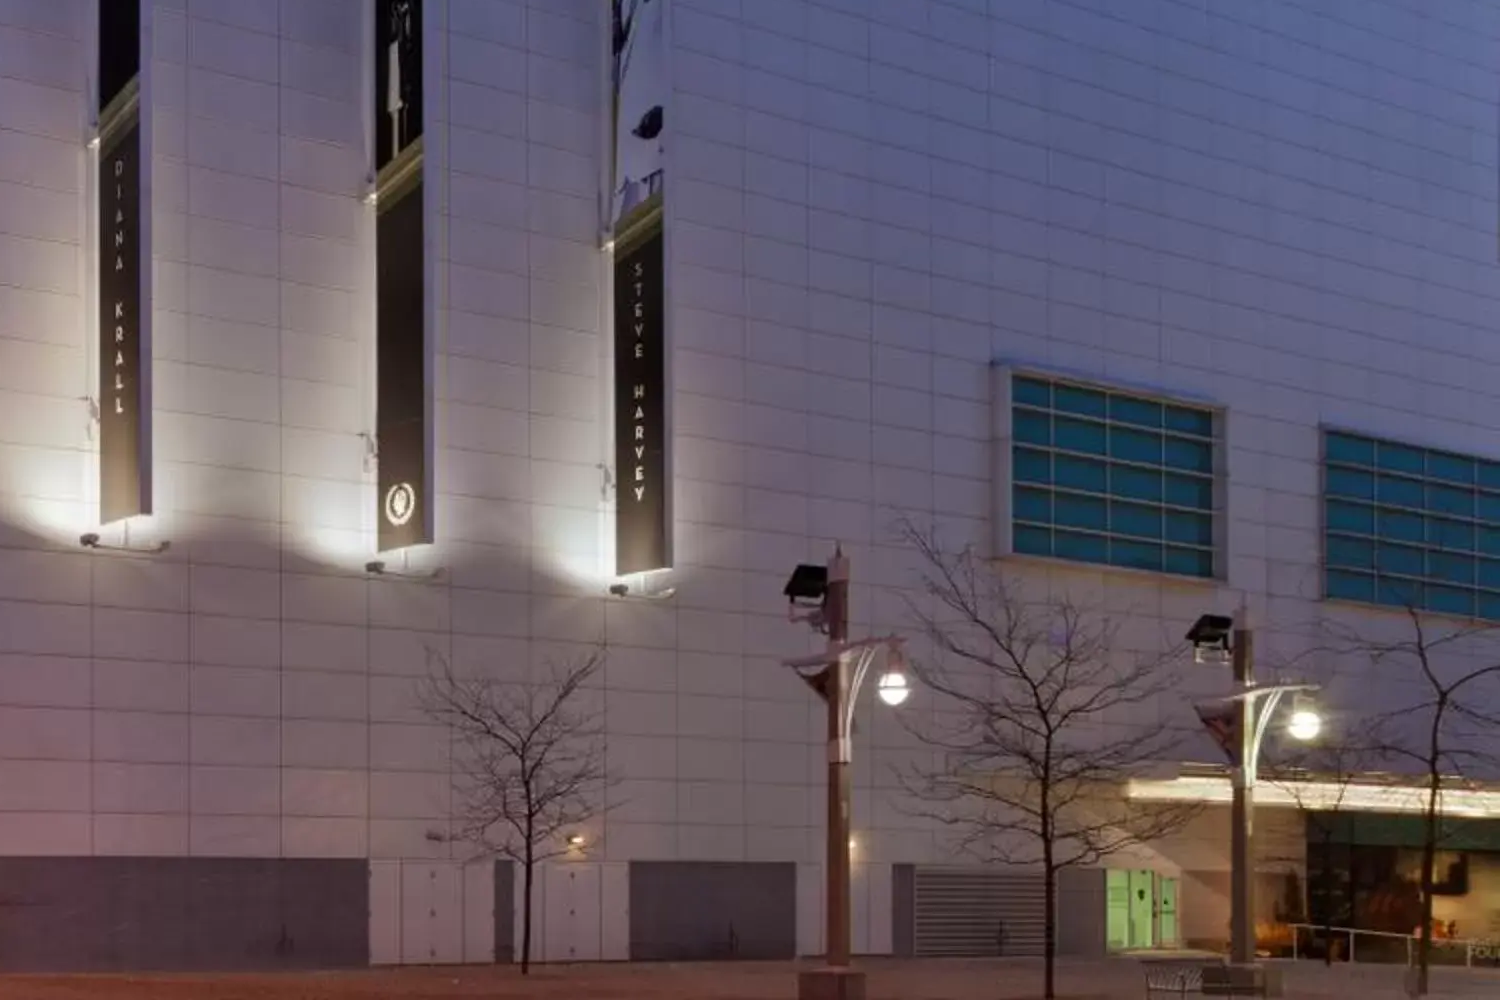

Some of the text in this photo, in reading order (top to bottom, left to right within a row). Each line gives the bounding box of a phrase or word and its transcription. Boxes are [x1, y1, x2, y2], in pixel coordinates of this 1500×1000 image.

[114, 159, 124, 414] DIANA KRALL
[634, 262, 645, 502] STEVE HARVEY
